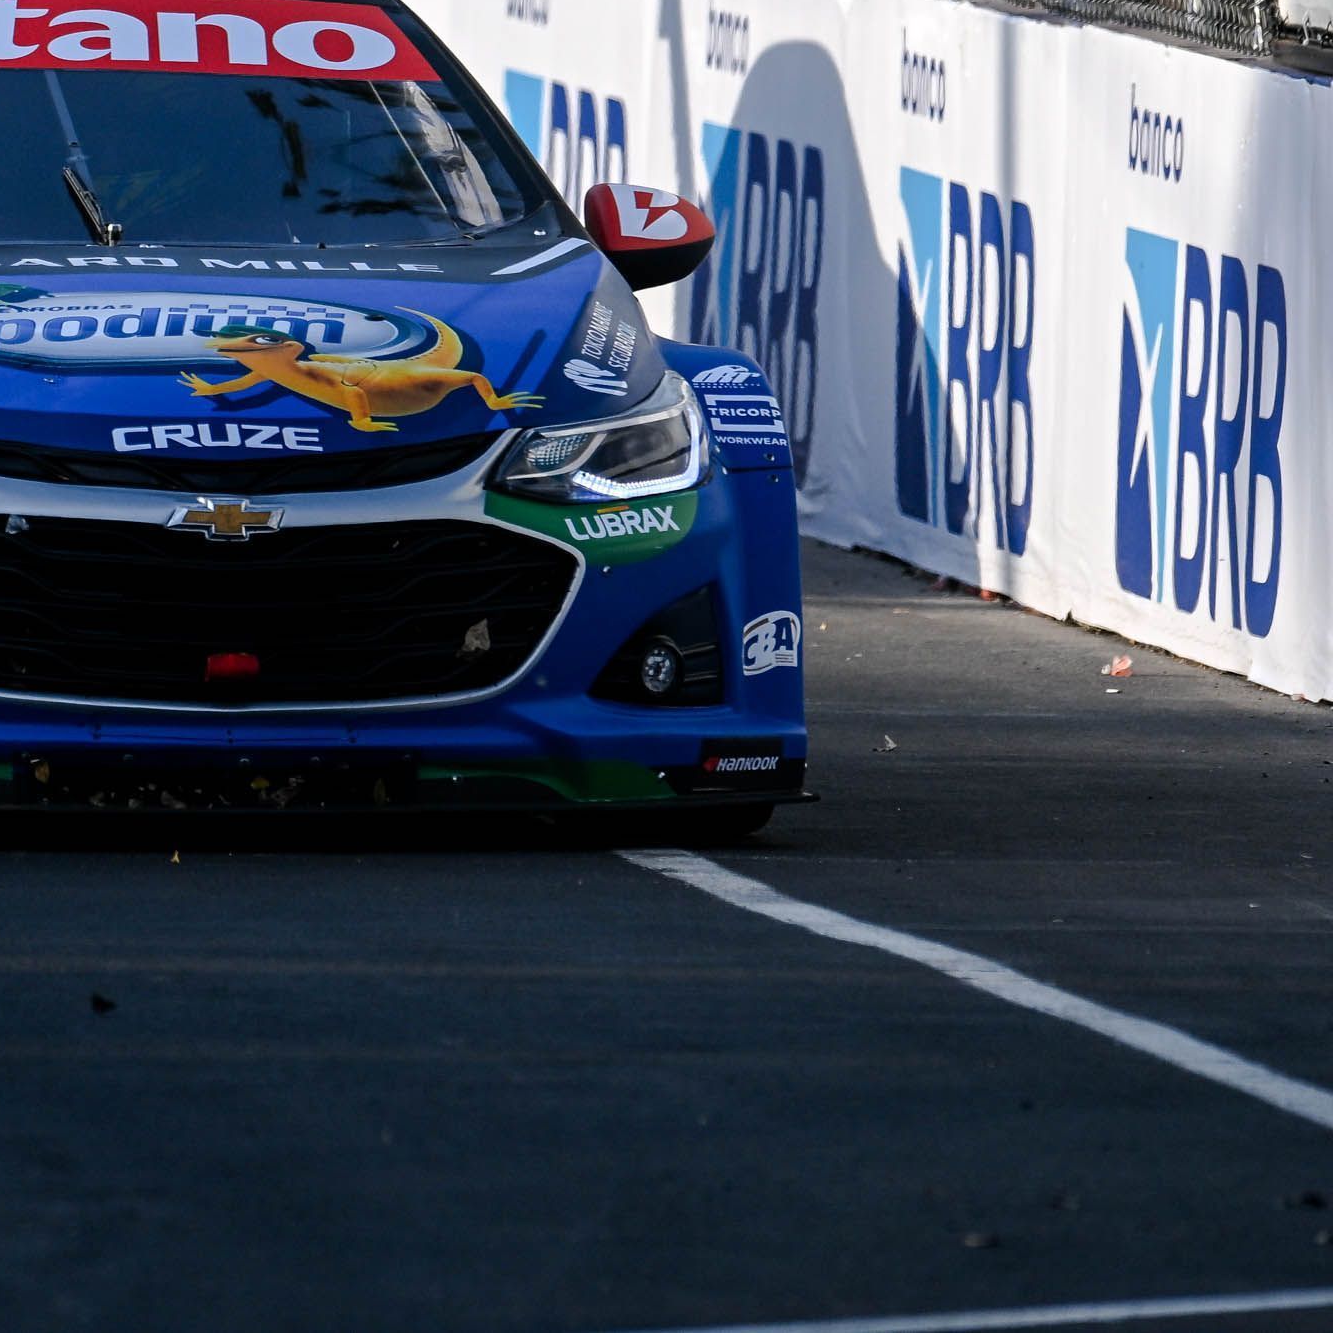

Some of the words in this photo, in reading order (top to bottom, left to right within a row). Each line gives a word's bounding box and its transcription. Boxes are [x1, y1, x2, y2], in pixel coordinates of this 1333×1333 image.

[900, 28, 947, 122] banco
[1127, 82, 1186, 185] banco
[200, 258, 446, 274] MILLE
[945, 180, 1036, 559] BRB
[708, 407, 782, 418] TRICORP
[112, 423, 324, 453] CRUZE
[715, 435, 788, 447] WORKWEAR
[1172, 245, 1288, 641] BRB
[564, 505, 681, 542] LUBRAX
[743, 617, 795, 667] CBA
